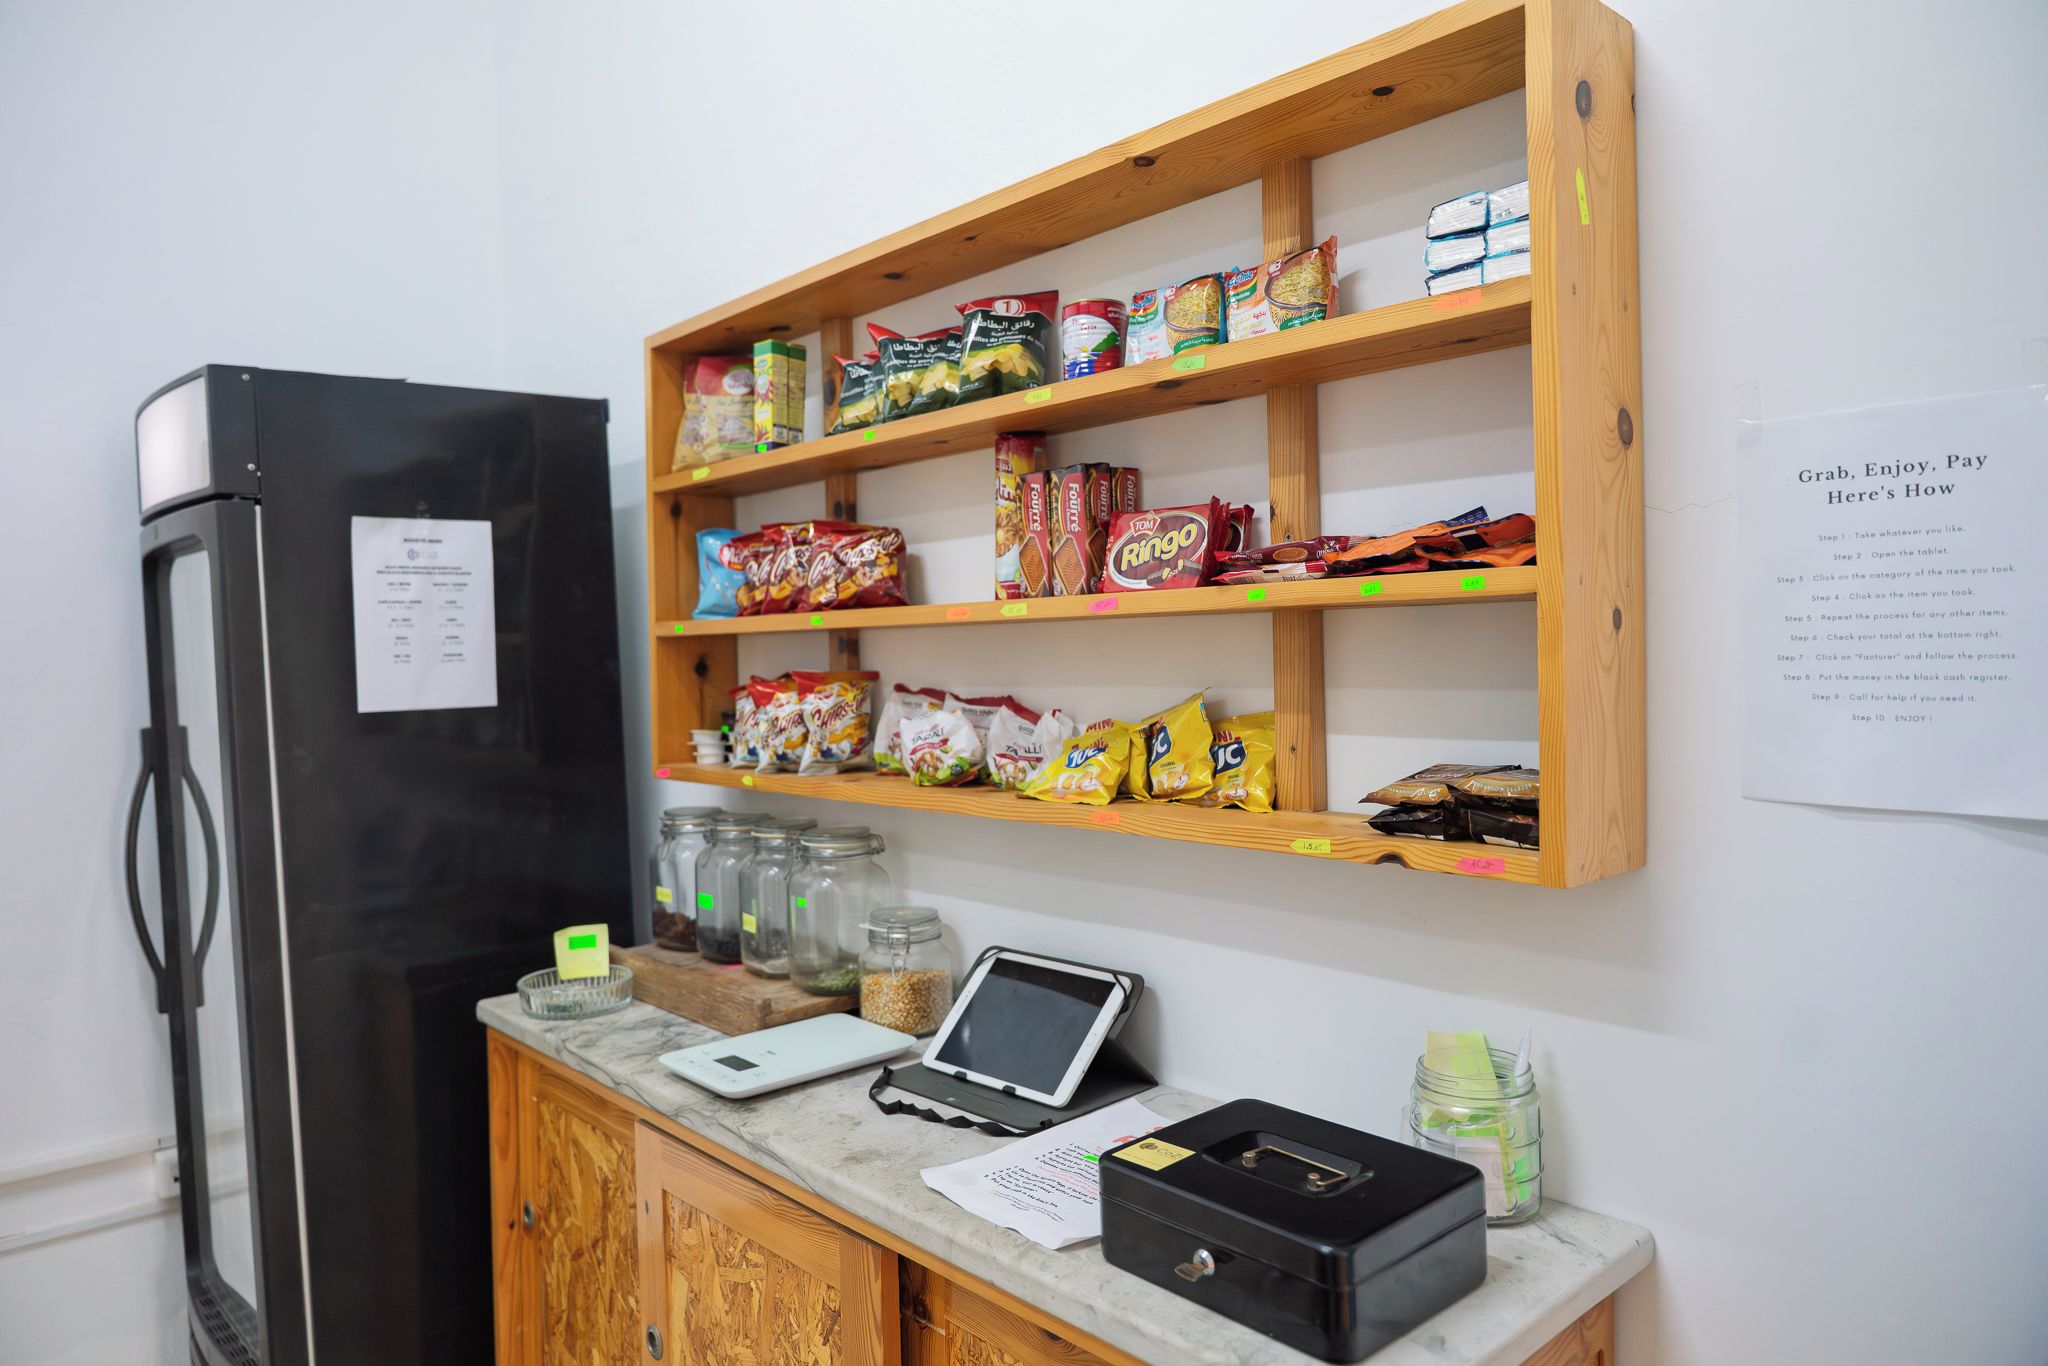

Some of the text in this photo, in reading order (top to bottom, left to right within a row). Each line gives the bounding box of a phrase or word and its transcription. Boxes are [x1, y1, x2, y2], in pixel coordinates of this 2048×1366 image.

[1798, 454, 1988, 483] Grab, Enjoy, Pay
[1098, 480, 1109, 520] Fourré
[1827, 483, 1956, 504] Here's How
[1029, 482, 1042, 532] Fourré
[1068, 482, 1082, 533] Fourré
[1135, 520, 1154, 531] TOM
[1818, 534, 1838, 543] Step
[1855, 531, 1876, 539] Take
[1879, 528, 1922, 537] whatever
[1926, 527, 1942, 536] you
[1946, 524, 1966, 533] like.
[1121, 523, 1198, 572] Ringo
[1833, 552, 1853, 561] Step
[1871, 551, 1895, 560] Open
[1899, 549, 1914, 557] the
[1918, 547, 1950, 556] tablet.
[1776, 576, 1795, 584] Step
[1813, 574, 1836, 582] Click
[1838, 574, 1849, 582] on
[1852, 572, 1866, 580] the
[1870, 570, 1911, 580] category
[1915, 568, 1924, 577] of
[1928, 568, 1943, 576] the
[1946, 567, 1968, 575] item
[1971, 567, 1988, 575] you
[1992, 564, 2016, 573] took.
[1812, 594, 1831, 602] Step
[1849, 592, 1872, 600] Click
[1889, 591, 1904, 599] the
[1908, 590, 1928, 598] item
[1931, 590, 1948, 599] you
[1952, 588, 1976, 597] took.
[1784, 615, 1804, 624] Step
[1821, 614, 1852, 624] Repeat
[1874, 613, 1908, 621] process
[1929, 611, 1946, 619] any
[1949, 609, 1975, 617] other
[1979, 609, 2008, 617] items.
[1790, 634, 1810, 642] Step
[1826, 633, 1854, 641] Check
[1858, 633, 1876, 642] your
[1880, 632, 1902, 640] total
[1919, 631, 1933, 639] the
[1937, 631, 1972, 639] bottom
[1976, 629, 2001, 640] right.
[1777, 654, 1796, 663] Step
[1816, 653, 1837, 661] Click
[1904, 652, 1921, 660] and
[1925, 652, 1954, 662] follow
[1958, 652, 1973, 660] the
[1977, 652, 2018, 661] process.
[1836, 673, 1849, 681] the
[1852, 674, 1881, 682] money
[1896, 673, 1910, 681] the
[1913, 673, 1939, 681] black
[1944, 673, 1965, 681] cash
[1969, 673, 2011, 683] register.
[1812, 693, 1831, 702] Step
[1849, 693, 1868, 701] Call
[1871, 693, 1884, 701] for
[1887, 694, 1906, 702] help
[1920, 696, 1937, 704] you
[1940, 694, 1964, 702] need
[1852, 714, 1872, 722] Step
[1875, 714, 1885, 722] 10
[1069, 749, 1101, 768] TUC
